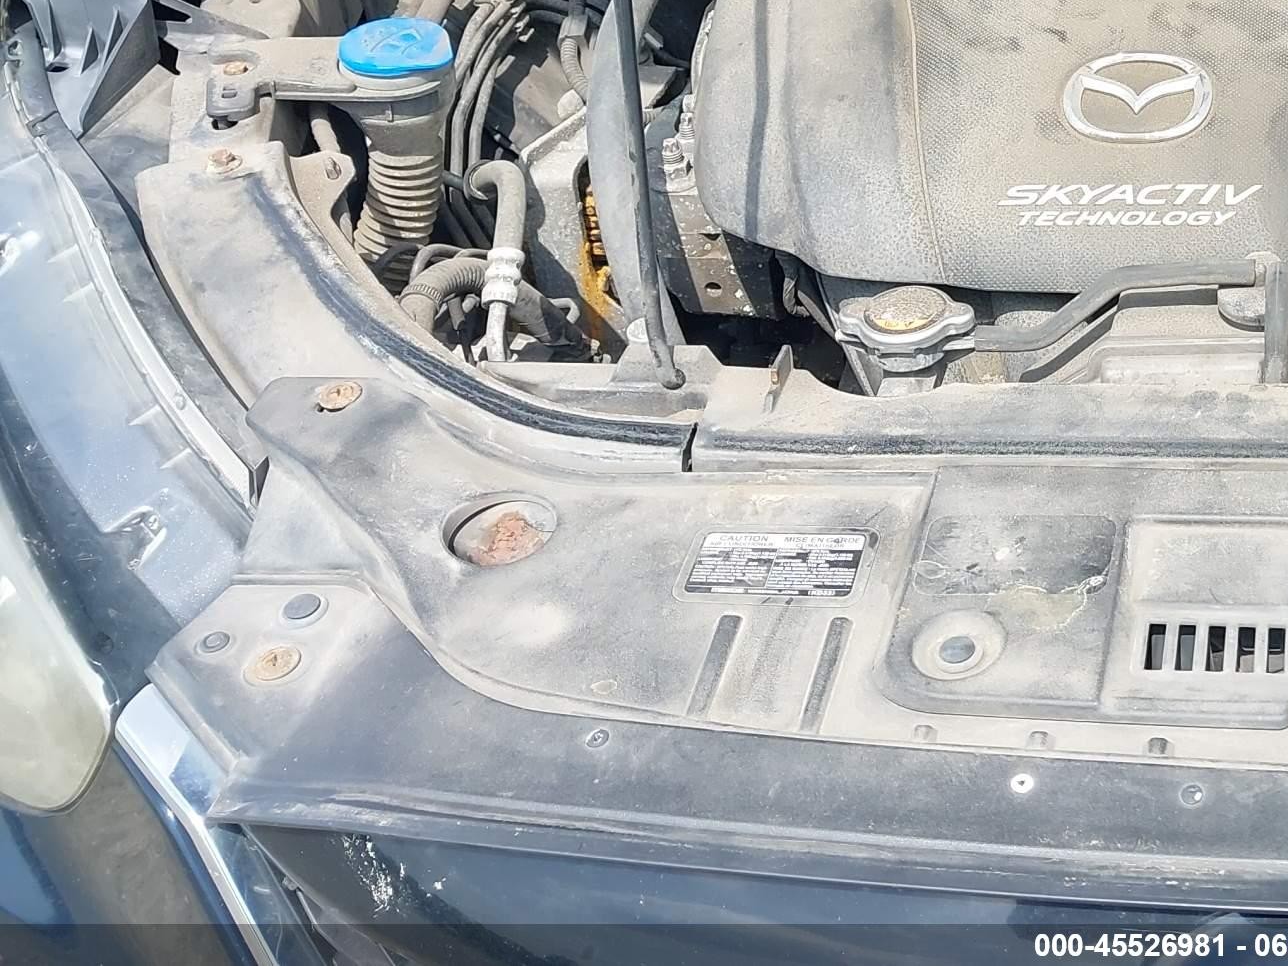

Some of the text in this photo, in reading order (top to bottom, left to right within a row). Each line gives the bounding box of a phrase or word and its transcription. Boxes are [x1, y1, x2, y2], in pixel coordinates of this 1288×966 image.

[997, 184, 1264, 206] SKYACTIV
[1018, 210, 1237, 226] TECHNOLOGY
[719, 535, 769, 543] CAUTION
